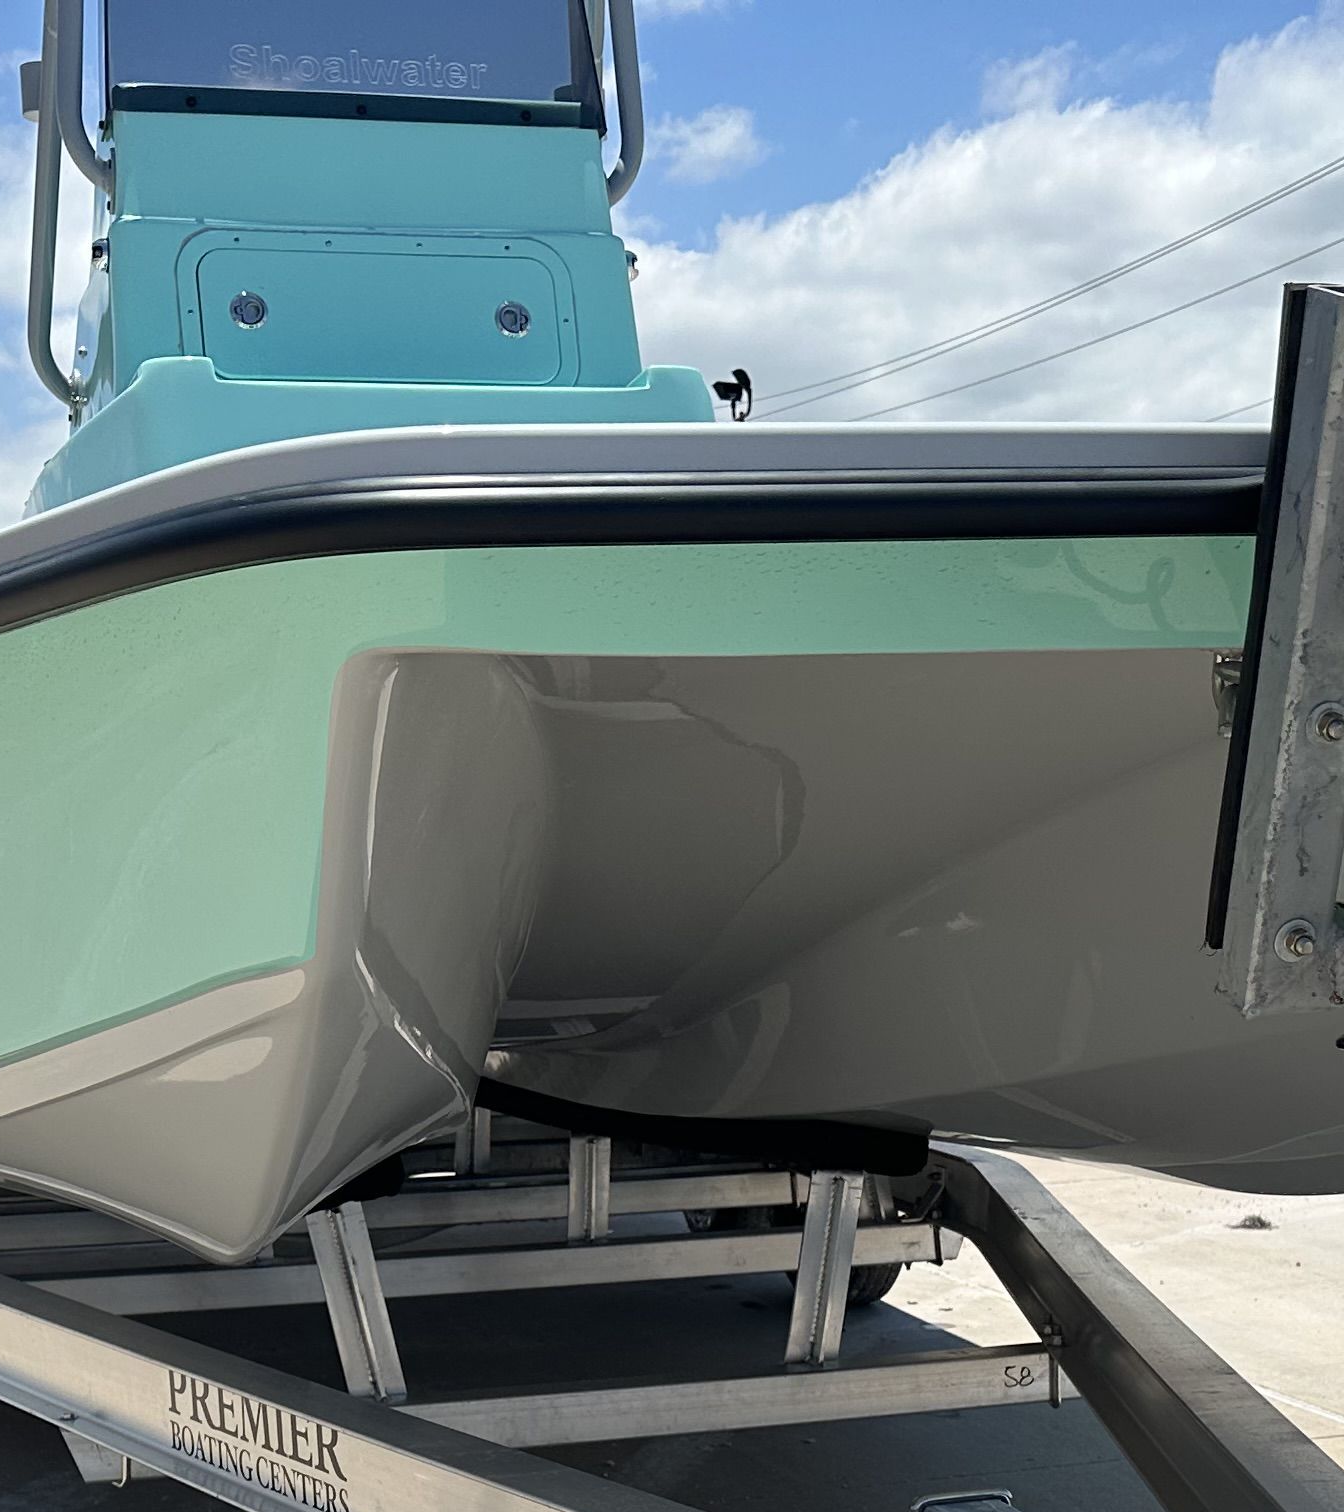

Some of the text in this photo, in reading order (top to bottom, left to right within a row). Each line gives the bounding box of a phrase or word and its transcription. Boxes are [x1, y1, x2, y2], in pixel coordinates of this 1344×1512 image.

[229, 43, 488, 90] Shoalwater
[168, 1369, 348, 1482] PREMIER
[169, 1420, 254, 1482] BOATING
